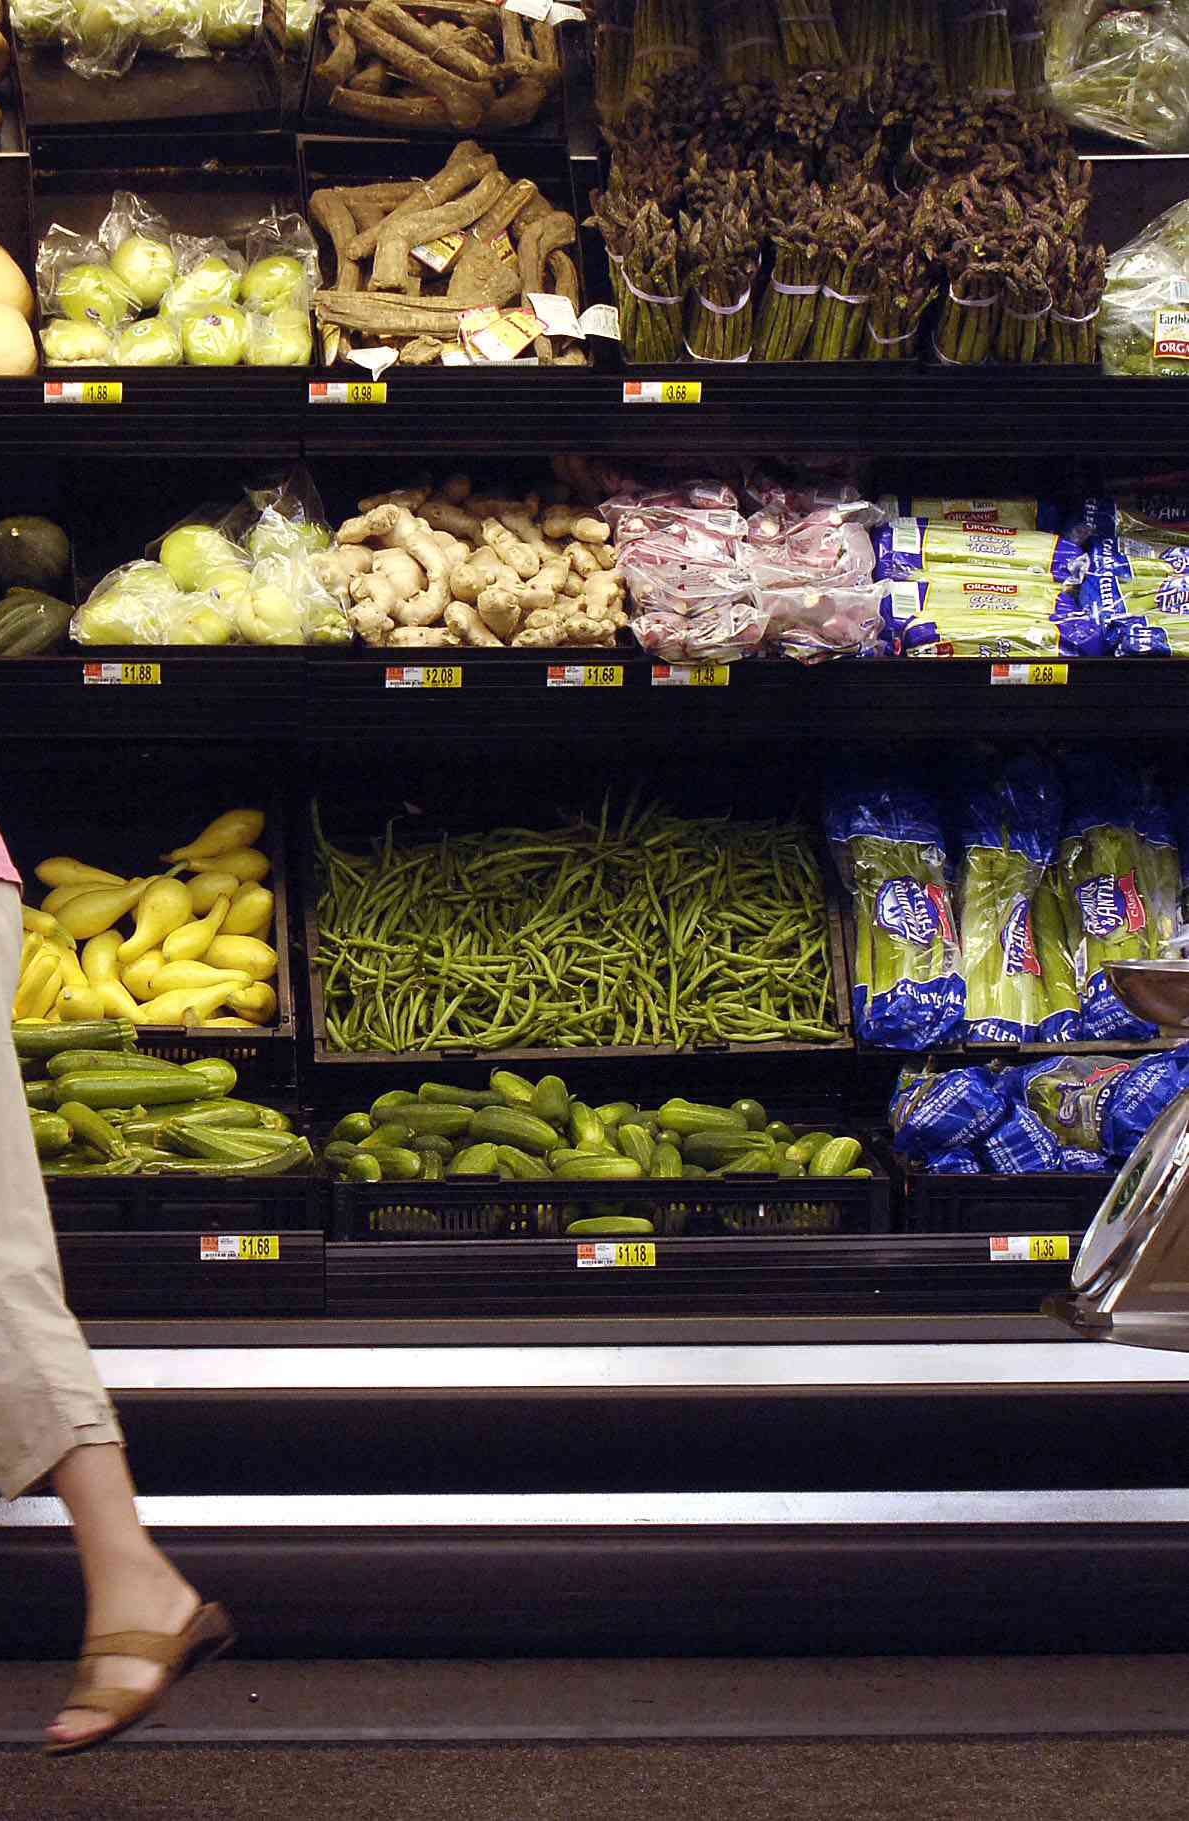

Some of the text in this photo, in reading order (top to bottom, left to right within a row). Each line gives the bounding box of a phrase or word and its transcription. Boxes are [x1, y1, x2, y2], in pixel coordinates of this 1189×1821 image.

[966, 584, 1016, 593] ORGANIC
[1138, 629, 1152, 652] HEA
[125, 665, 151, 681] $1.88
[426, 669, 453, 684] $2.08
[587, 668, 614, 682] $1.68
[897, 983, 938, 1005] CELRY
[977, 1021, 1021, 1043] CELER
[242, 1238, 270, 1256] $1.68
[618, 1245, 646, 1263] $1.18
